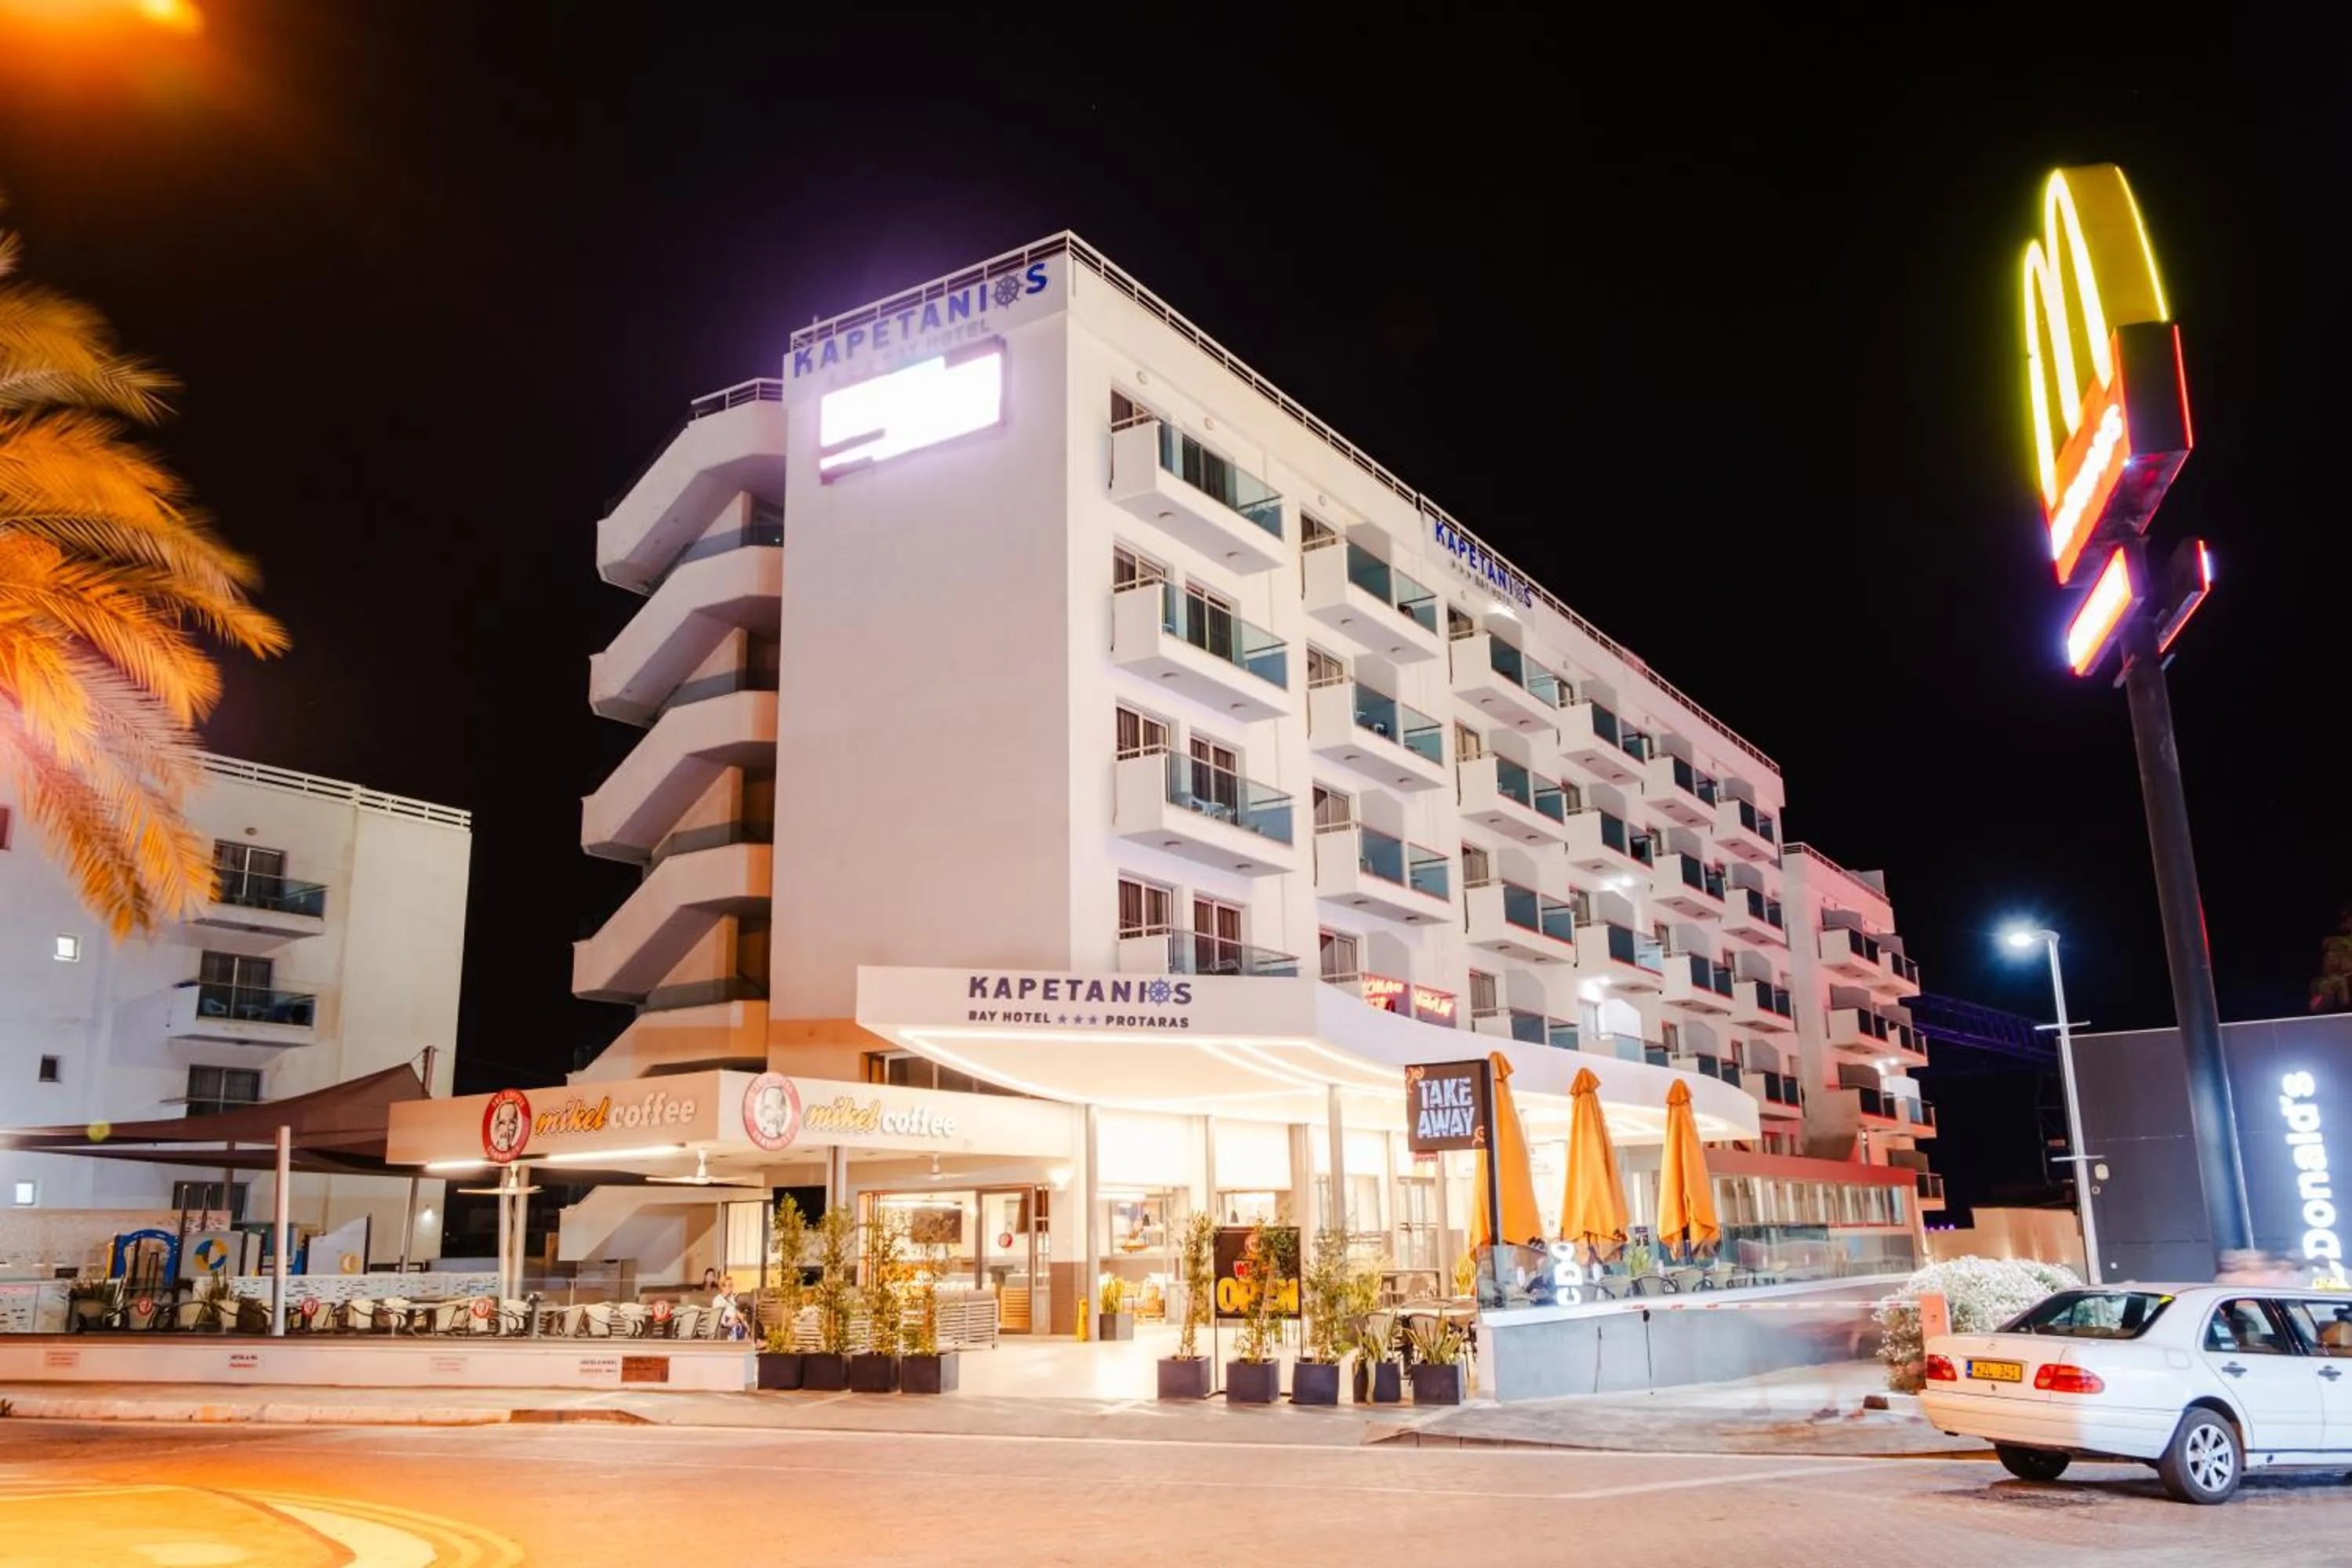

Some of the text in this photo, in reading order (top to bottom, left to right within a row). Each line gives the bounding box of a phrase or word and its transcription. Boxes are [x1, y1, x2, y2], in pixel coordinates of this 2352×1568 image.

[793, 262, 1048, 379] KAPETANIOS
[968, 976, 1192, 1007] KAPETANIOS
[968, 1010, 1190, 1029] BAY HOTEL PROTARAS
[1417, 1076, 1473, 1109] TAKE
[535, 1094, 612, 1137] mikel
[609, 1091, 696, 1130] coffee
[804, 1095, 956, 1138] mikel coffee
[1417, 1106, 1475, 1139] AWAY
[2278, 1070, 2347, 1288] Donald's
